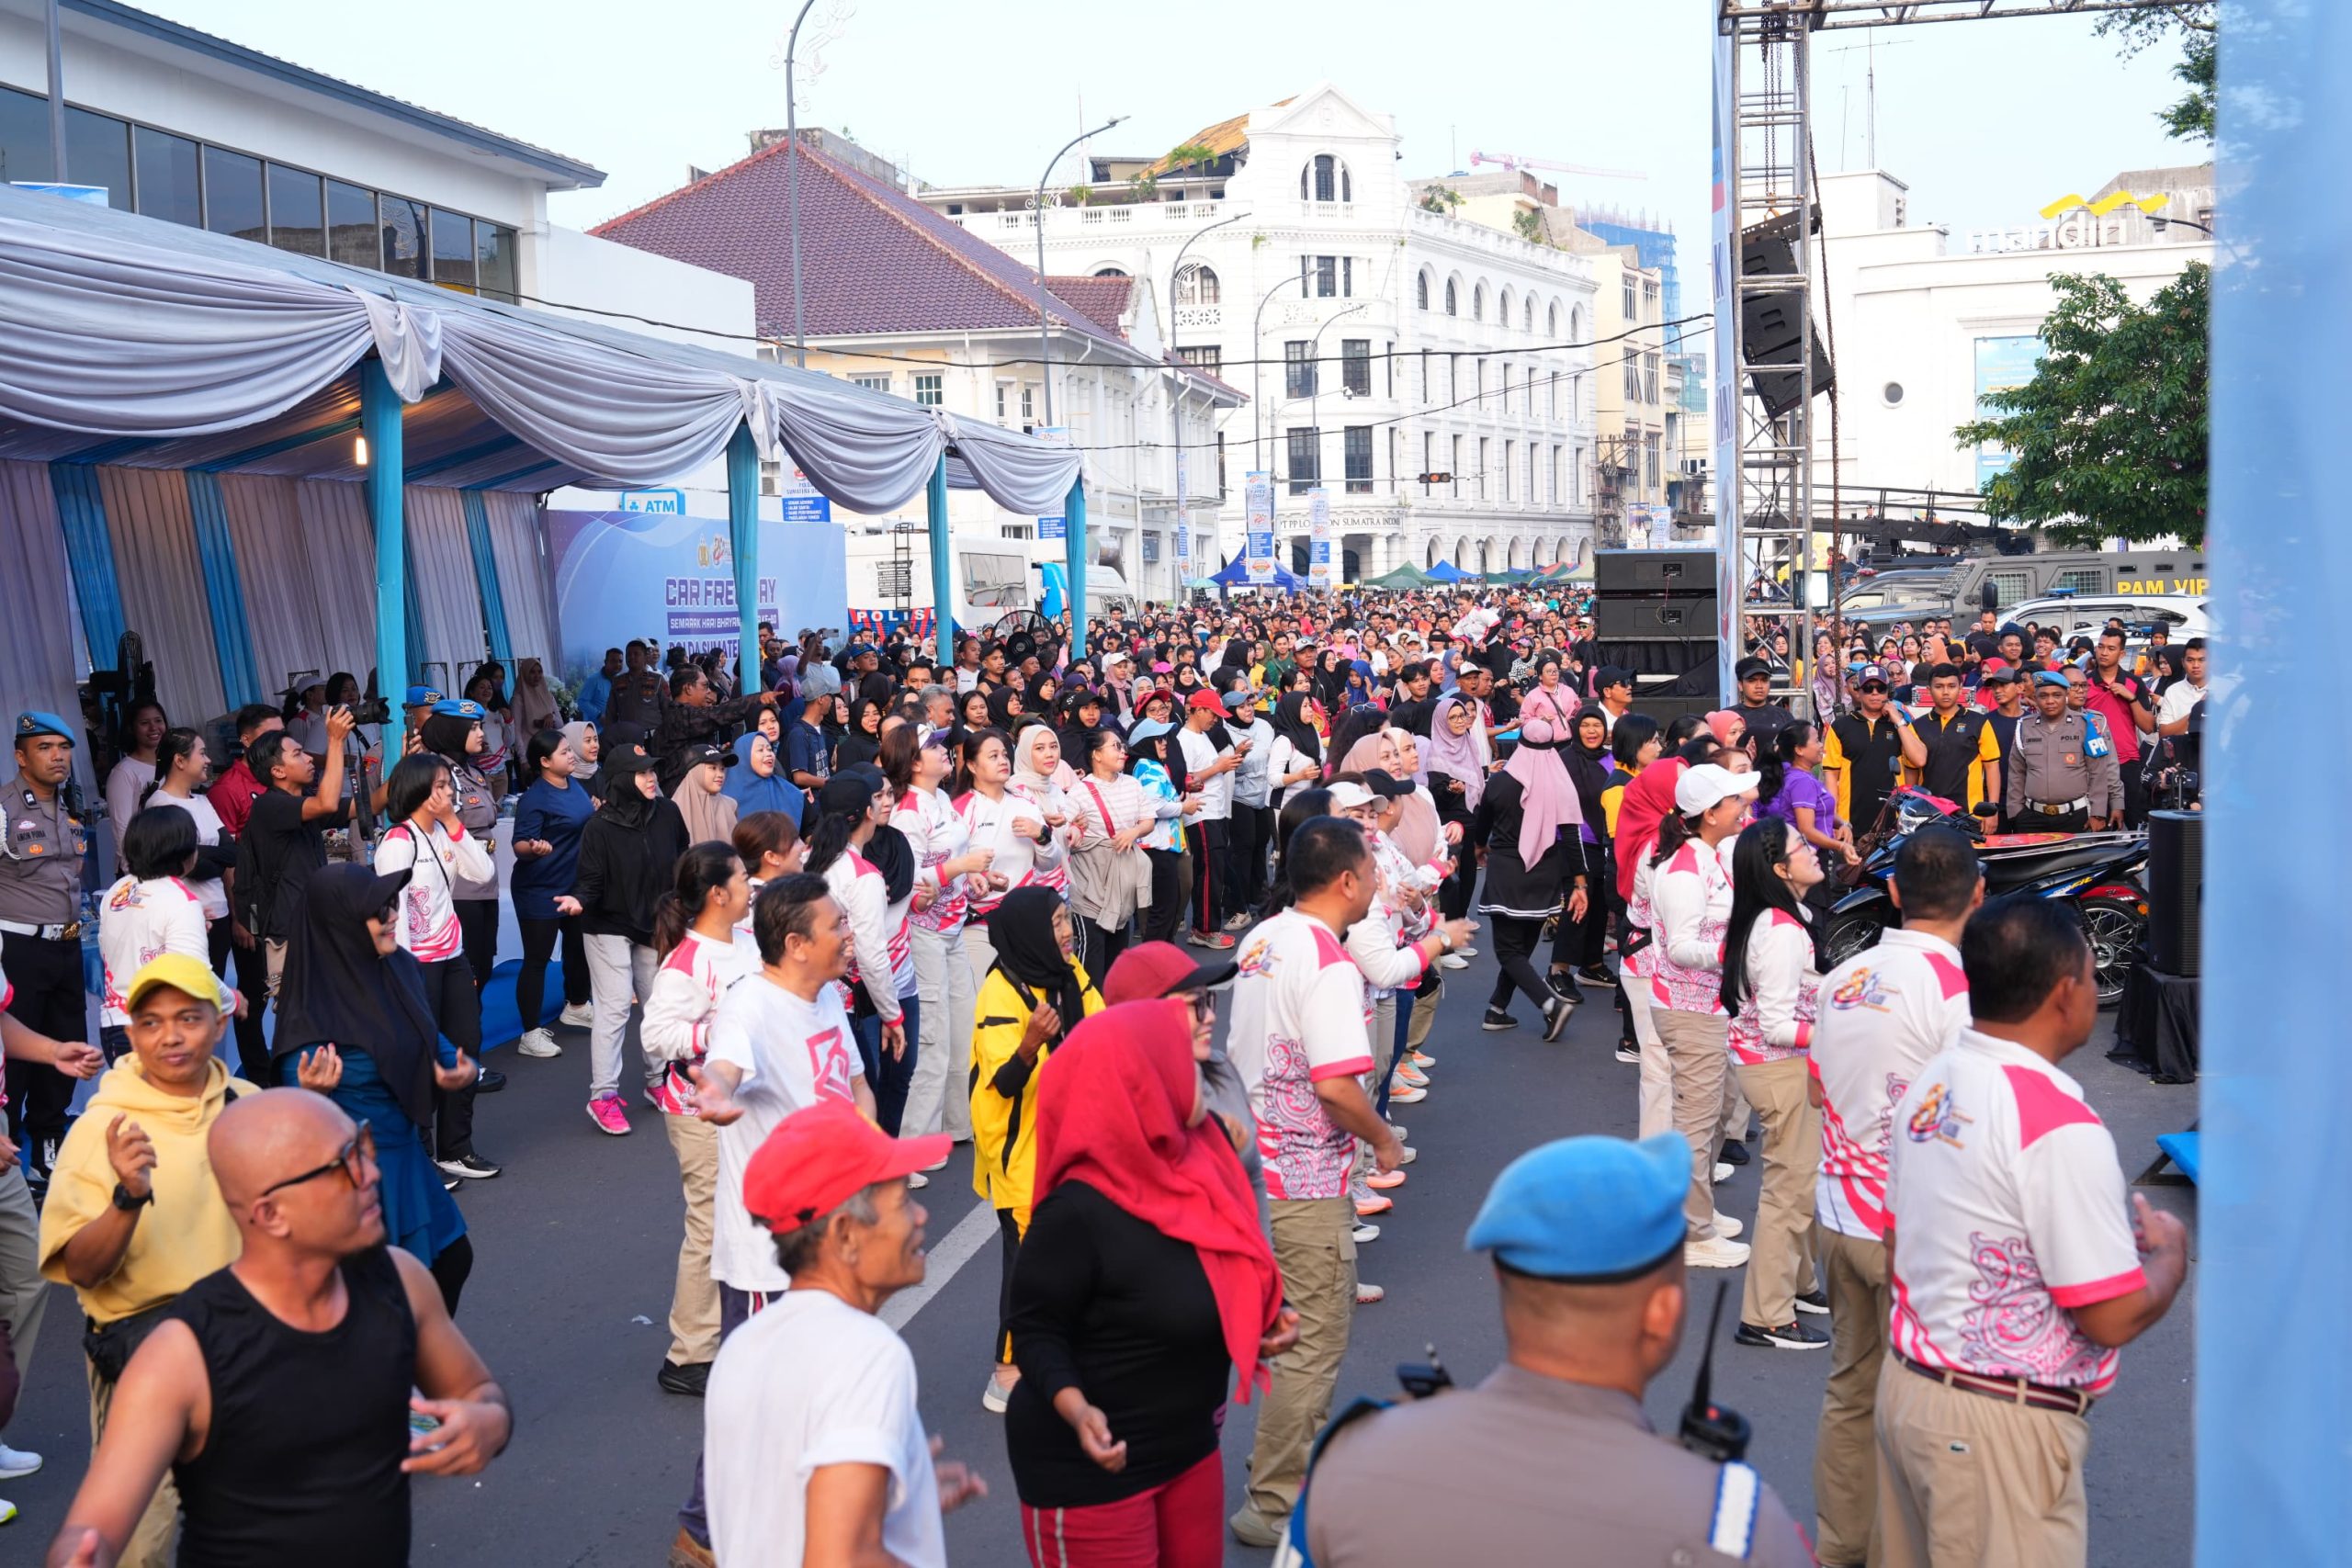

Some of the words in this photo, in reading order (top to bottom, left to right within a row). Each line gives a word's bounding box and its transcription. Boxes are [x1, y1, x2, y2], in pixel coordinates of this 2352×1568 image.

[1966, 209, 2127, 254] mandiri
[644, 500, 675, 513] ATM
[1299, 518, 1340, 528] LOON
[1342, 517, 1381, 526] SUMATRA
[666, 578, 700, 606] CAR
[703, 579, 739, 607] FRE
[2117, 580, 2165, 596] PAM
[2173, 578, 2210, 596] VIP
[670, 618, 701, 629] SEMARAK
[701, 617, 717, 628] HARI
[702, 639, 740, 659] SUMATE
